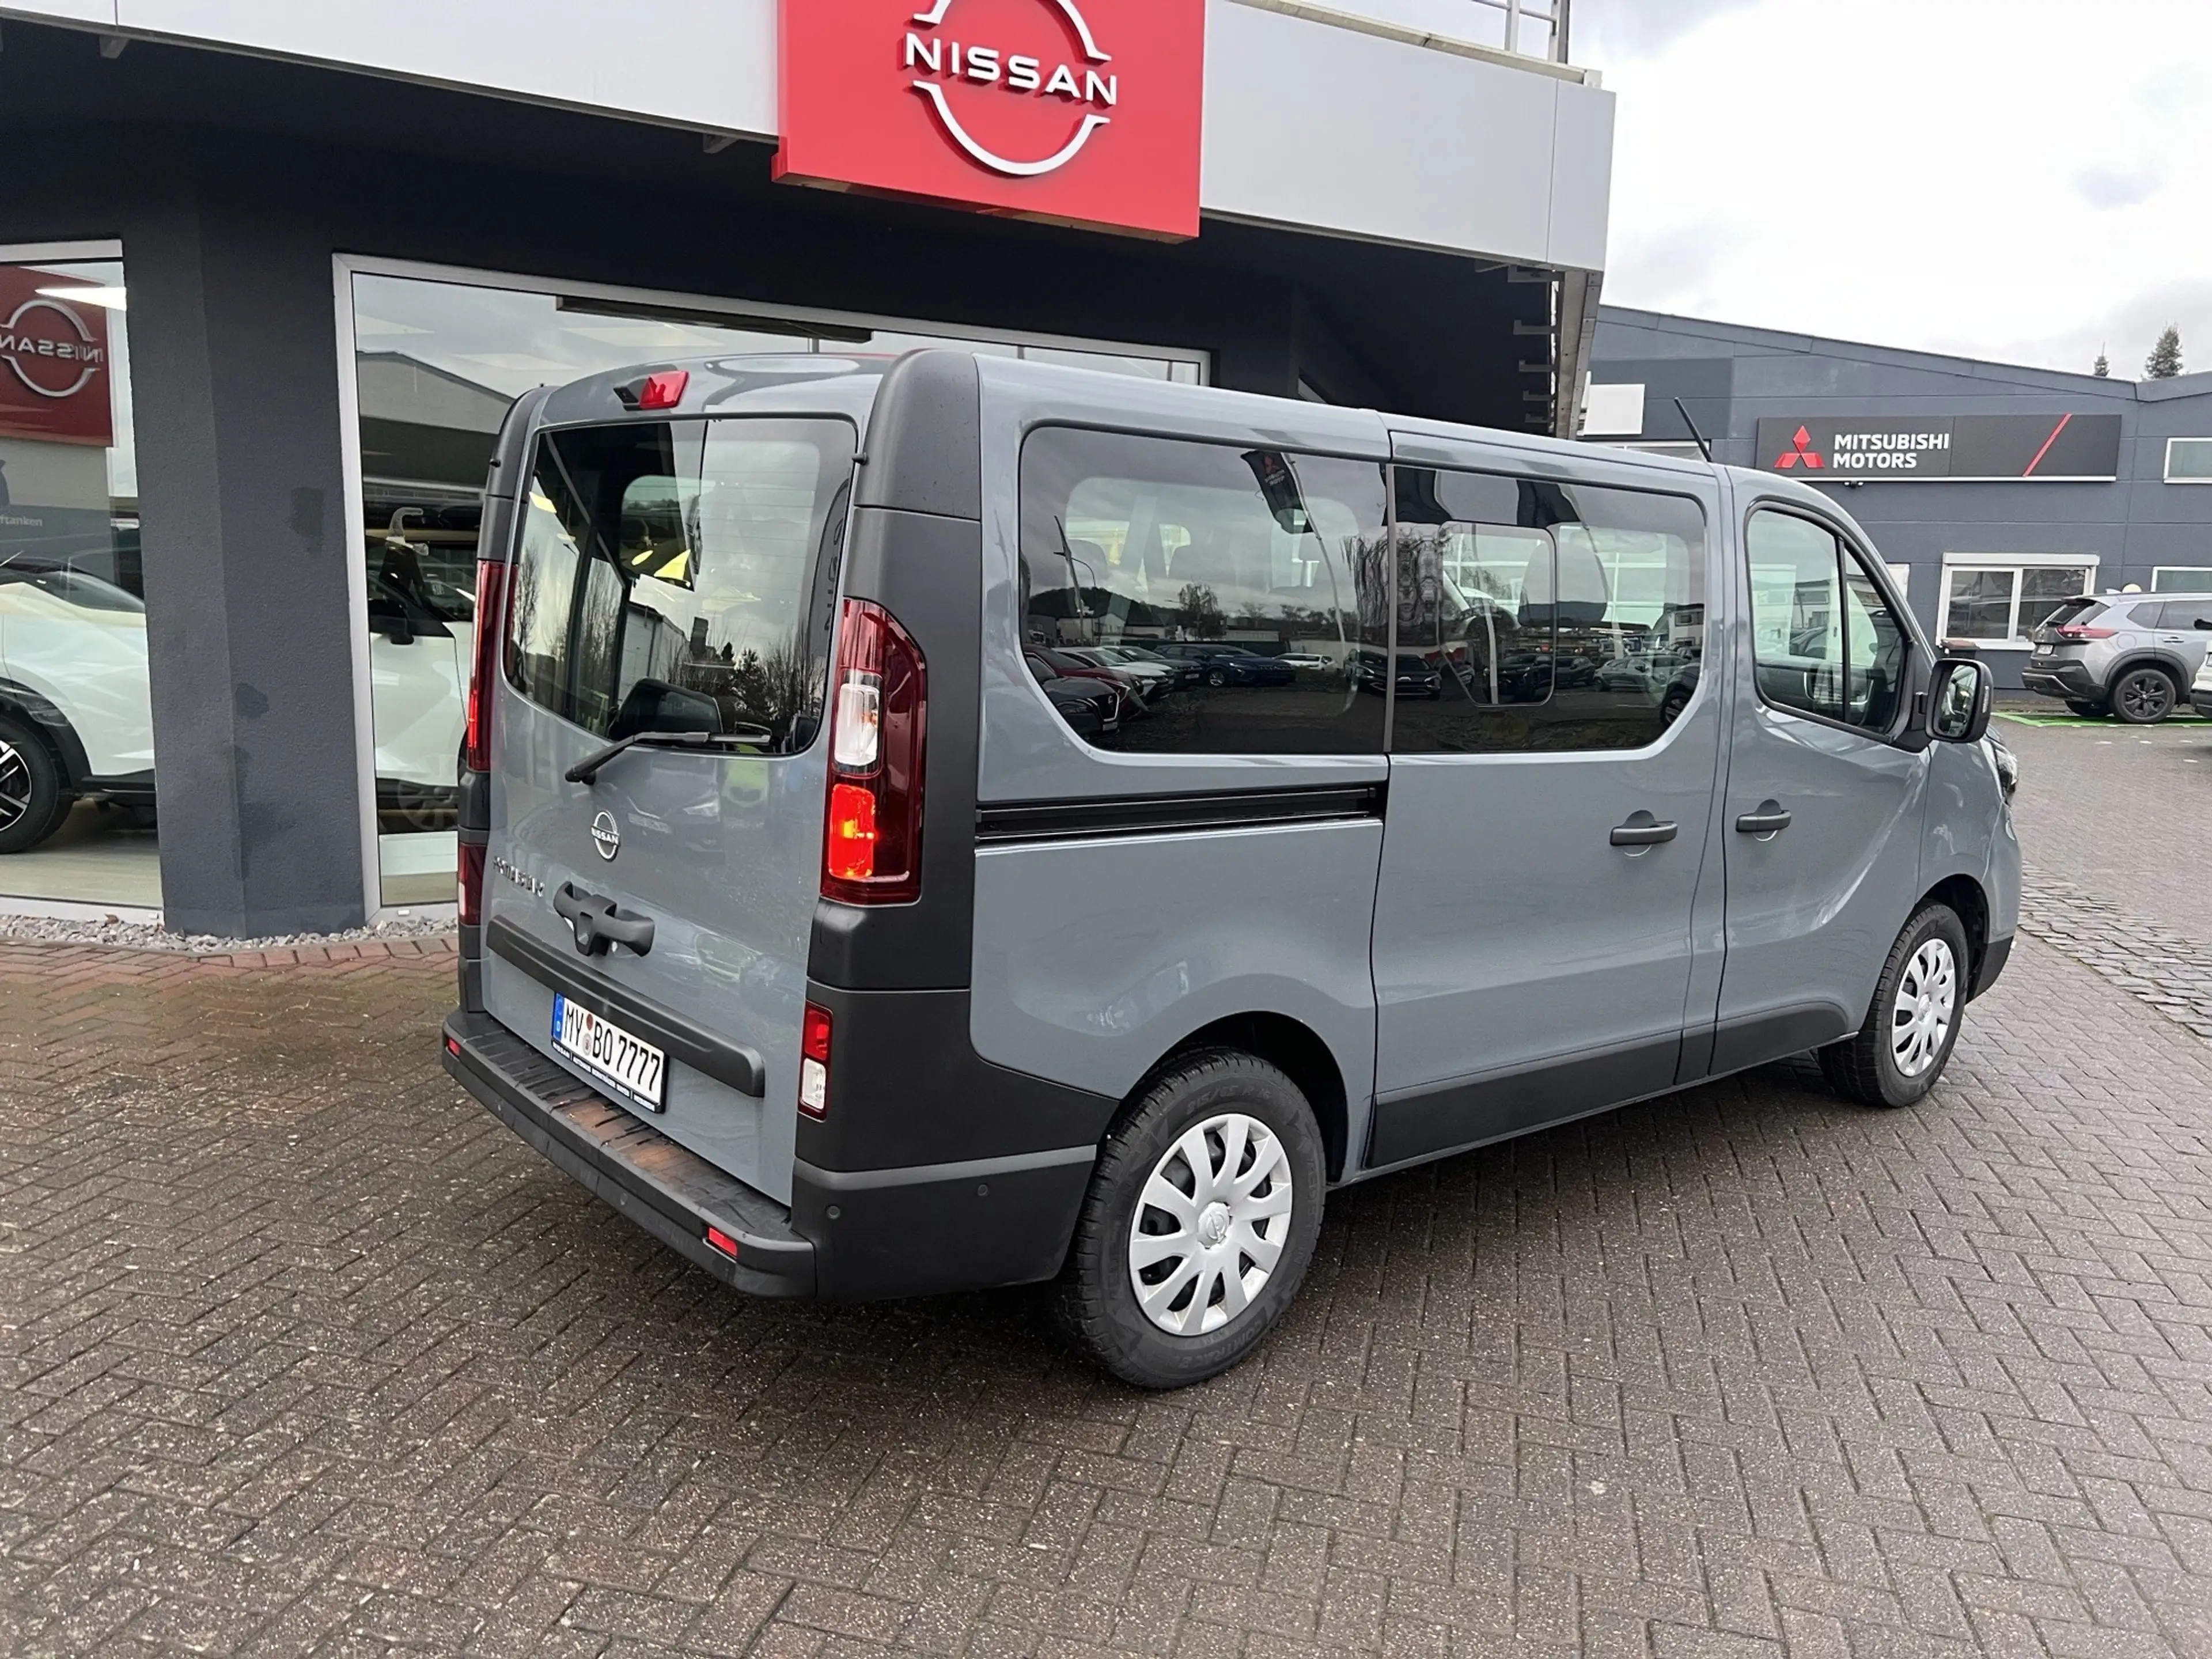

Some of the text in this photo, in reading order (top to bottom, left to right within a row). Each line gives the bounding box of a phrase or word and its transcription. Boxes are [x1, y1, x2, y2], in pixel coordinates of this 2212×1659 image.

[906, 32, 1117, 105] NISSAN
[1833, 452, 1917, 468] MOTORS
[1835, 433, 1949, 450] MITSUBISHI
[564, 1003, 584, 1046] MY
[592, 1021, 613, 1066] BO
[616, 1035, 660, 1091] 7777
